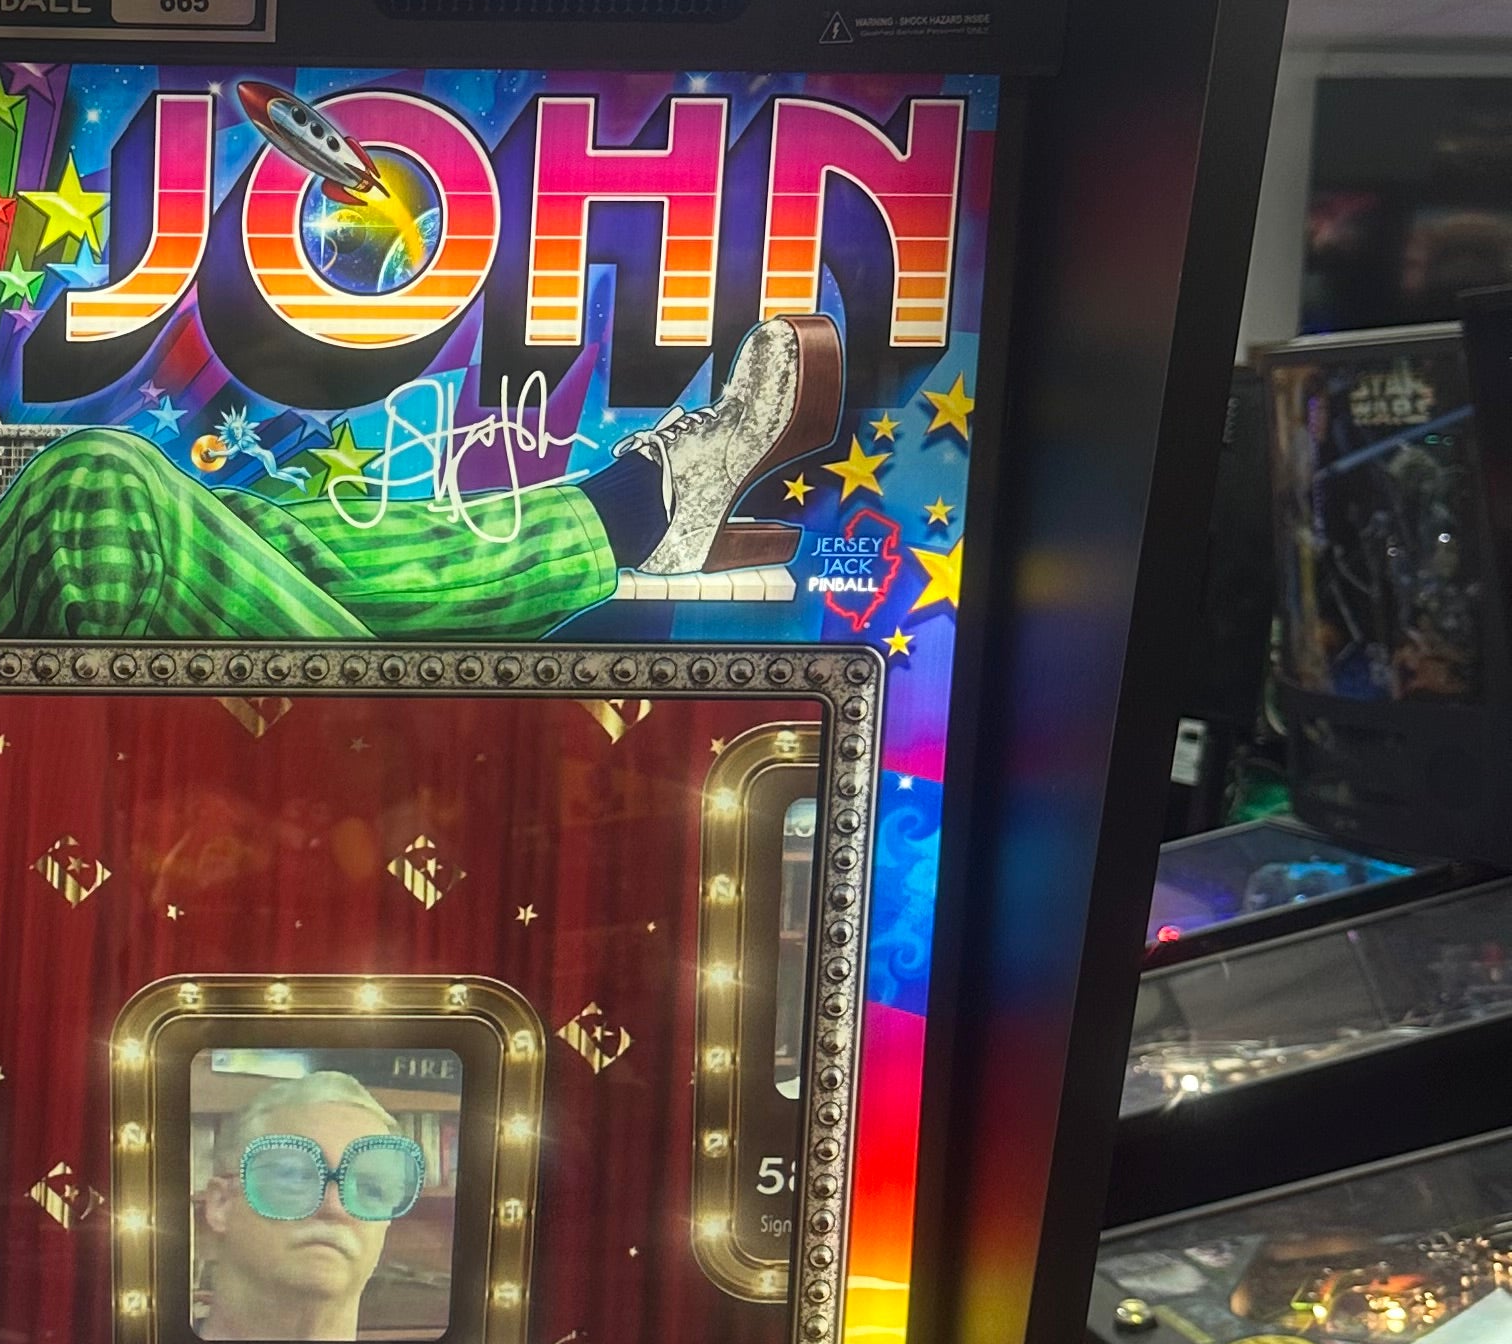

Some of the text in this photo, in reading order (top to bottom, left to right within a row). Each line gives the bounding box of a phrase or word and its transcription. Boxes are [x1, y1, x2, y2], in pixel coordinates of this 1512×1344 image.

[855, 16, 893, 27] WARNING
[899, 16, 928, 26] SHOCK
[929, 15, 963, 25] HAZARD
[65, 89, 966, 348] JOHN
[811, 537, 883, 556] JERSEY
[817, 558, 873, 578] JACK
[808, 577, 879, 592] PINBALL
[393, 1057, 455, 1079] FIRE
[756, 1157, 797, 1195] 5
